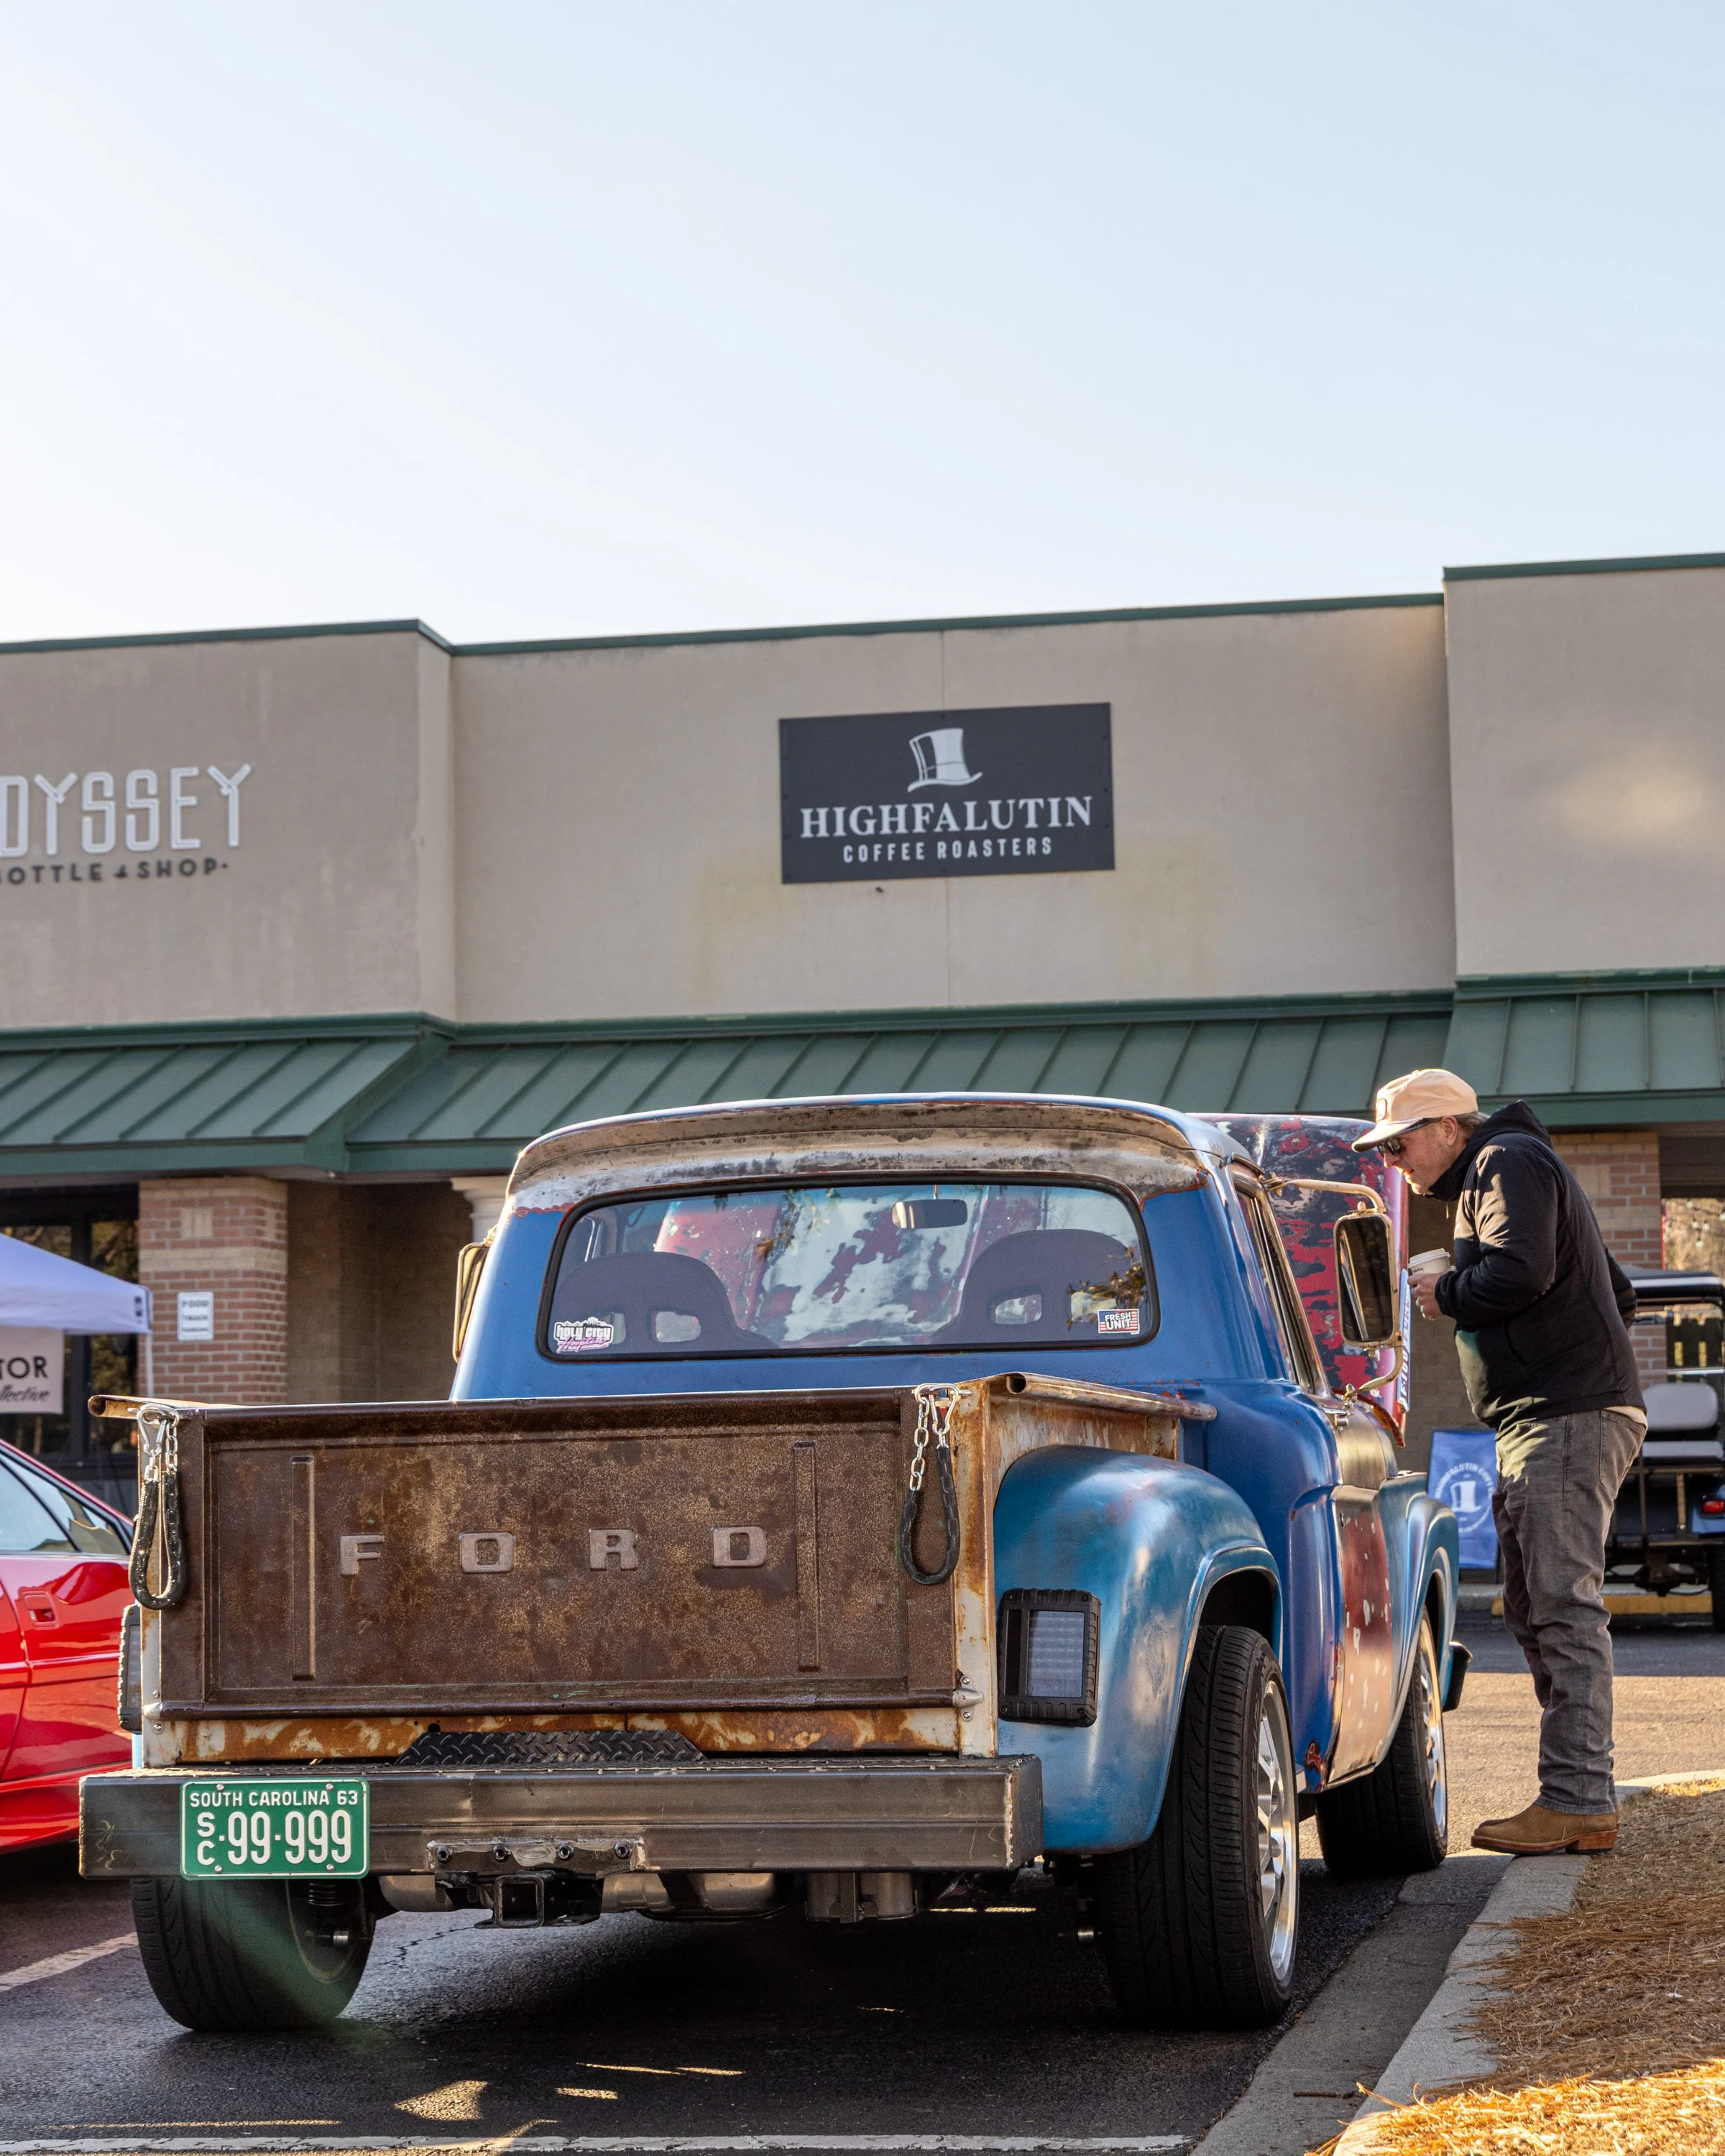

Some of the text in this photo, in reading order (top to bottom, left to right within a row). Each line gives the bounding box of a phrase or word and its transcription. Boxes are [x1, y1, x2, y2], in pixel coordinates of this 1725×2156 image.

[800, 796, 1093, 839] HIGHFALUTIN
[843, 837, 1052, 864] COFFEE ROASTERS
[0, 864, 103, 885] OTTLE
[1105, 1312, 1131, 1322] FRESH
[1105, 1319, 1131, 1330] UNIT
[340, 1525, 768, 1577] FORD
[190, 1790, 358, 1807] SOUTH CAROLINA 63
